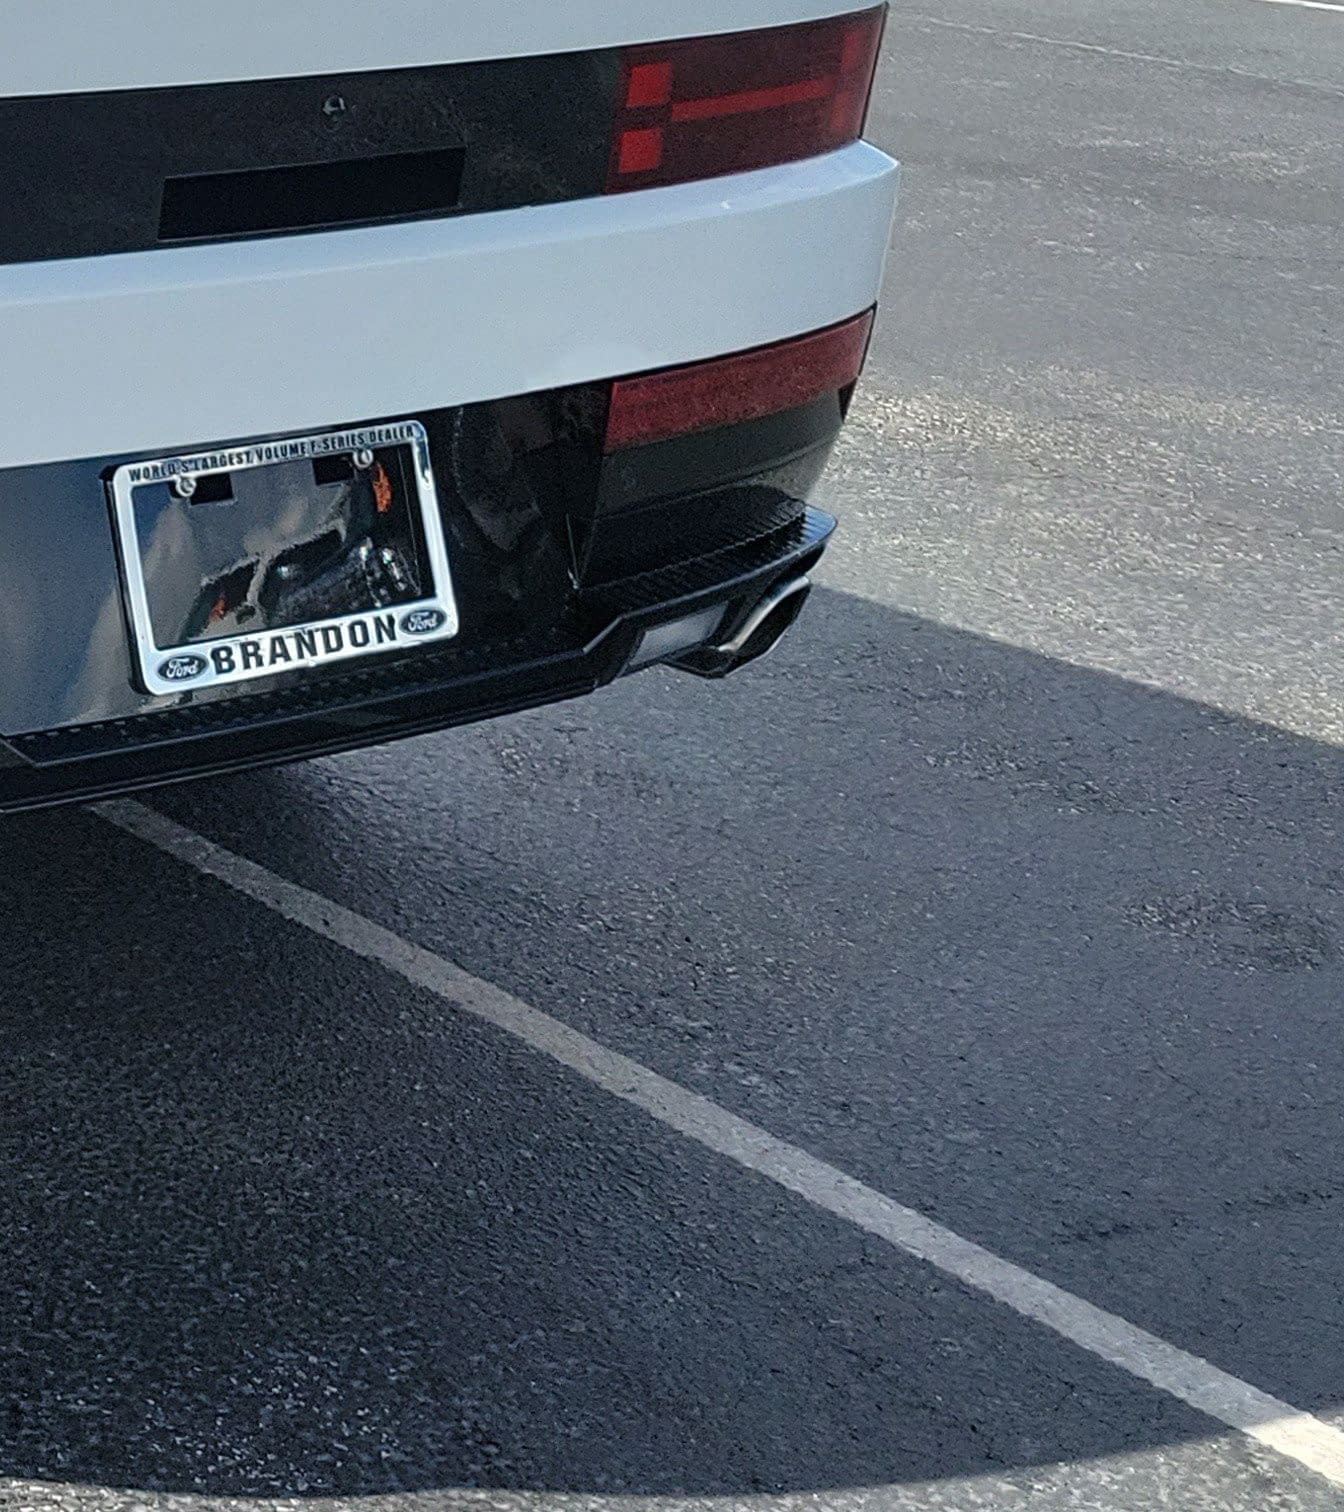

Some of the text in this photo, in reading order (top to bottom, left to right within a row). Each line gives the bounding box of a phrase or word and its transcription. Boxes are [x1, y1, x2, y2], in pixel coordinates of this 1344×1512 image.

[193, 450, 252, 471] LARGEST
[255, 441, 306, 462] VOLUME
[311, 431, 365, 453] F-SERIES
[369, 424, 414, 442] DEALER
[165, 612, 440, 679] Ford BRANDON Ford
